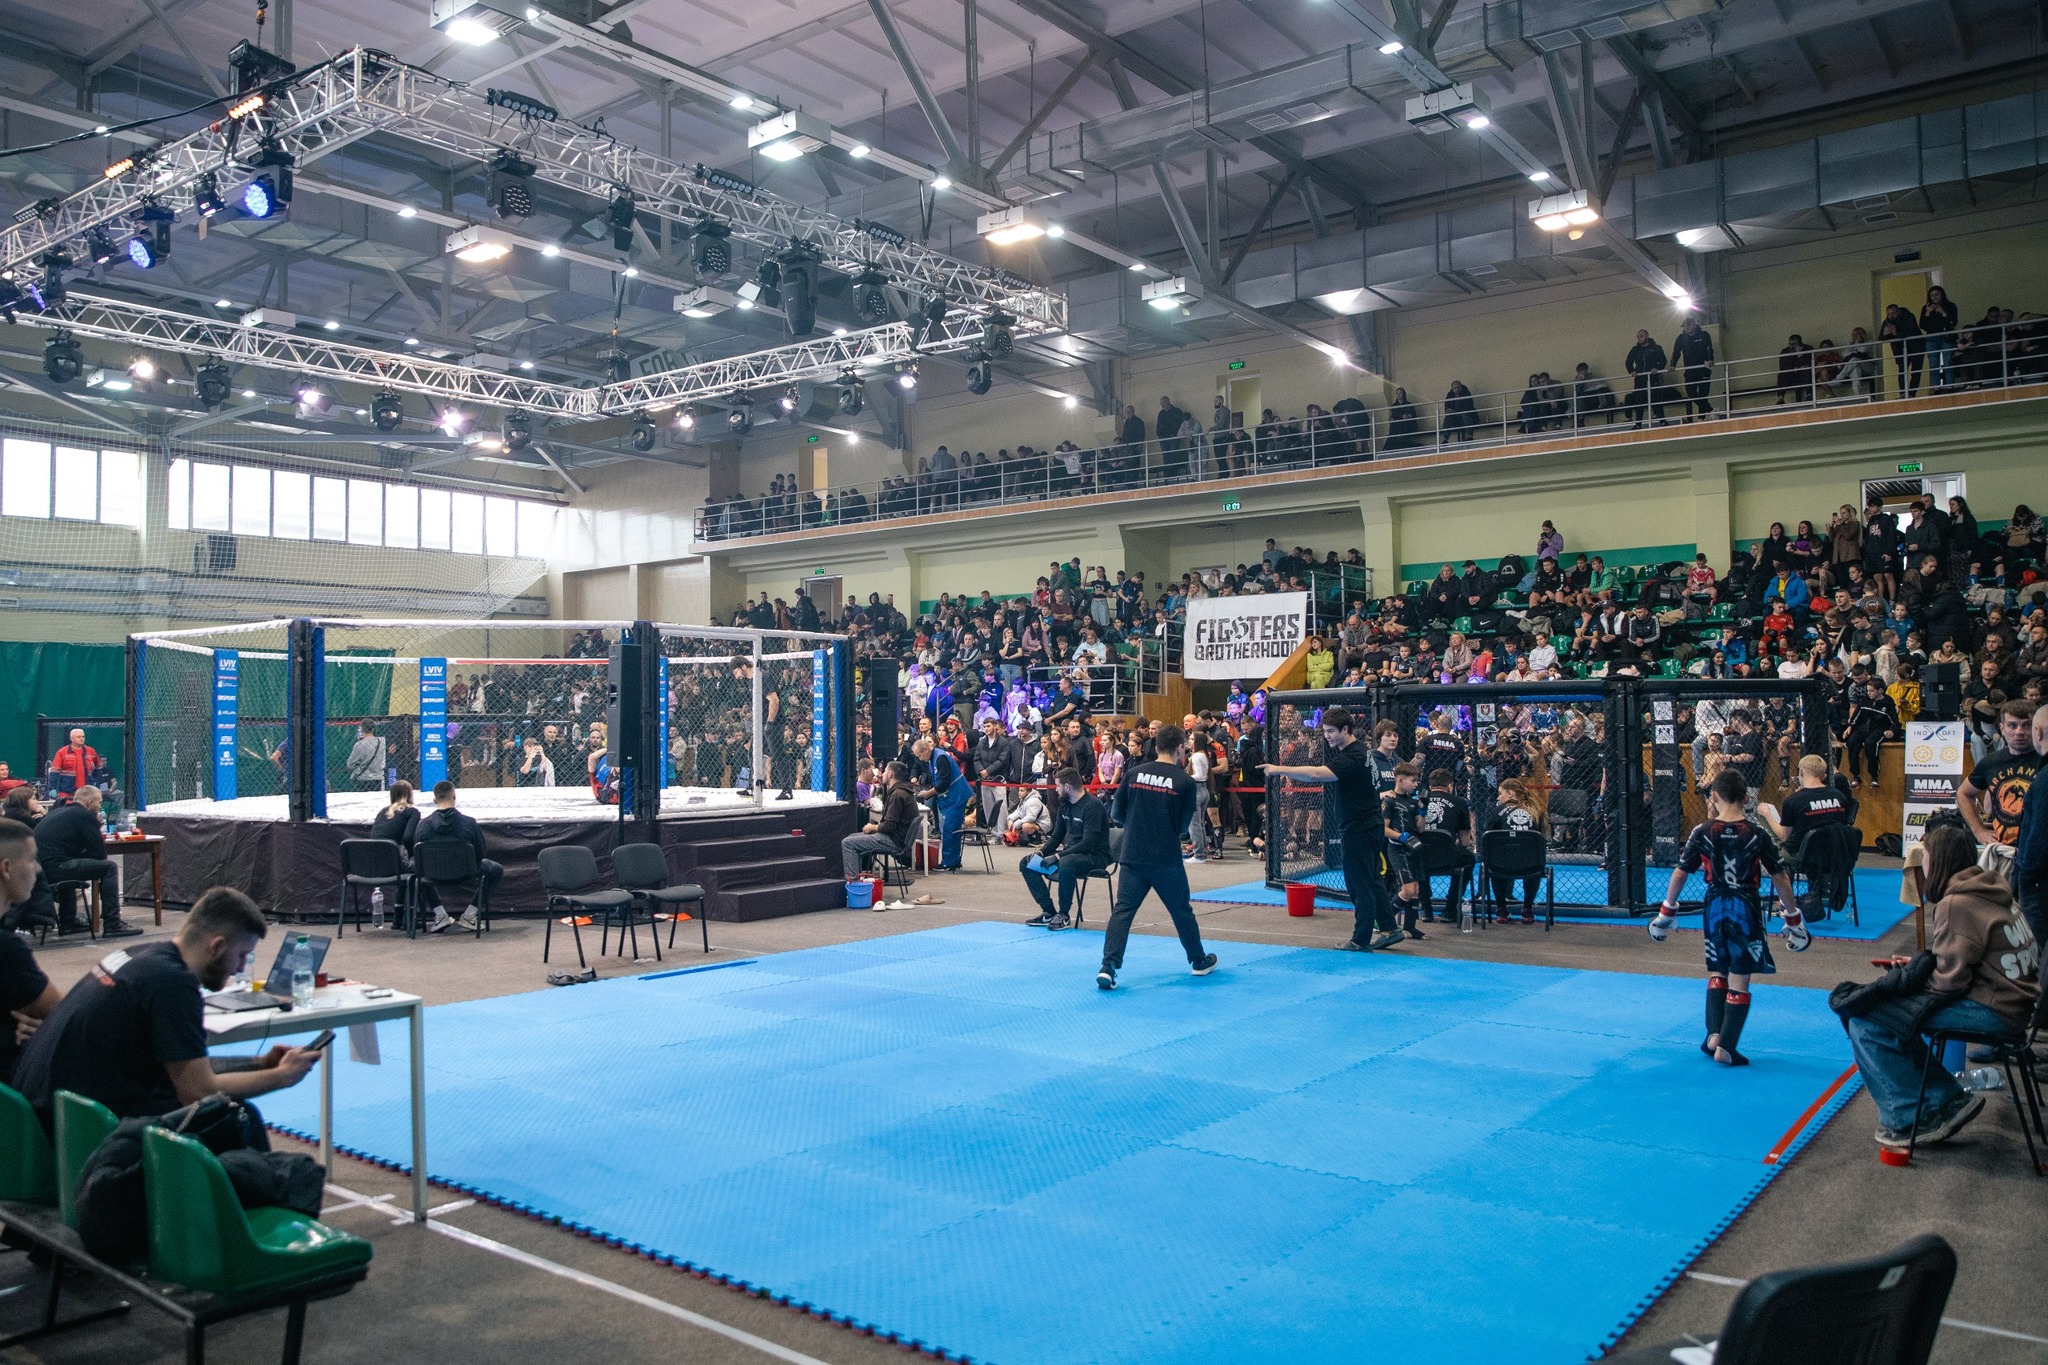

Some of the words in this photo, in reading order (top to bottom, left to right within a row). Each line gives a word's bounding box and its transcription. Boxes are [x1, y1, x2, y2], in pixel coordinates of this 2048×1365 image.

[219, 660, 236, 668] LVIV
[1433, 739, 1455, 749] MMA
[1136, 772, 1173, 789] MMA
[1914, 779, 1953, 790] MMA
[1809, 798, 1841, 811] MMA
